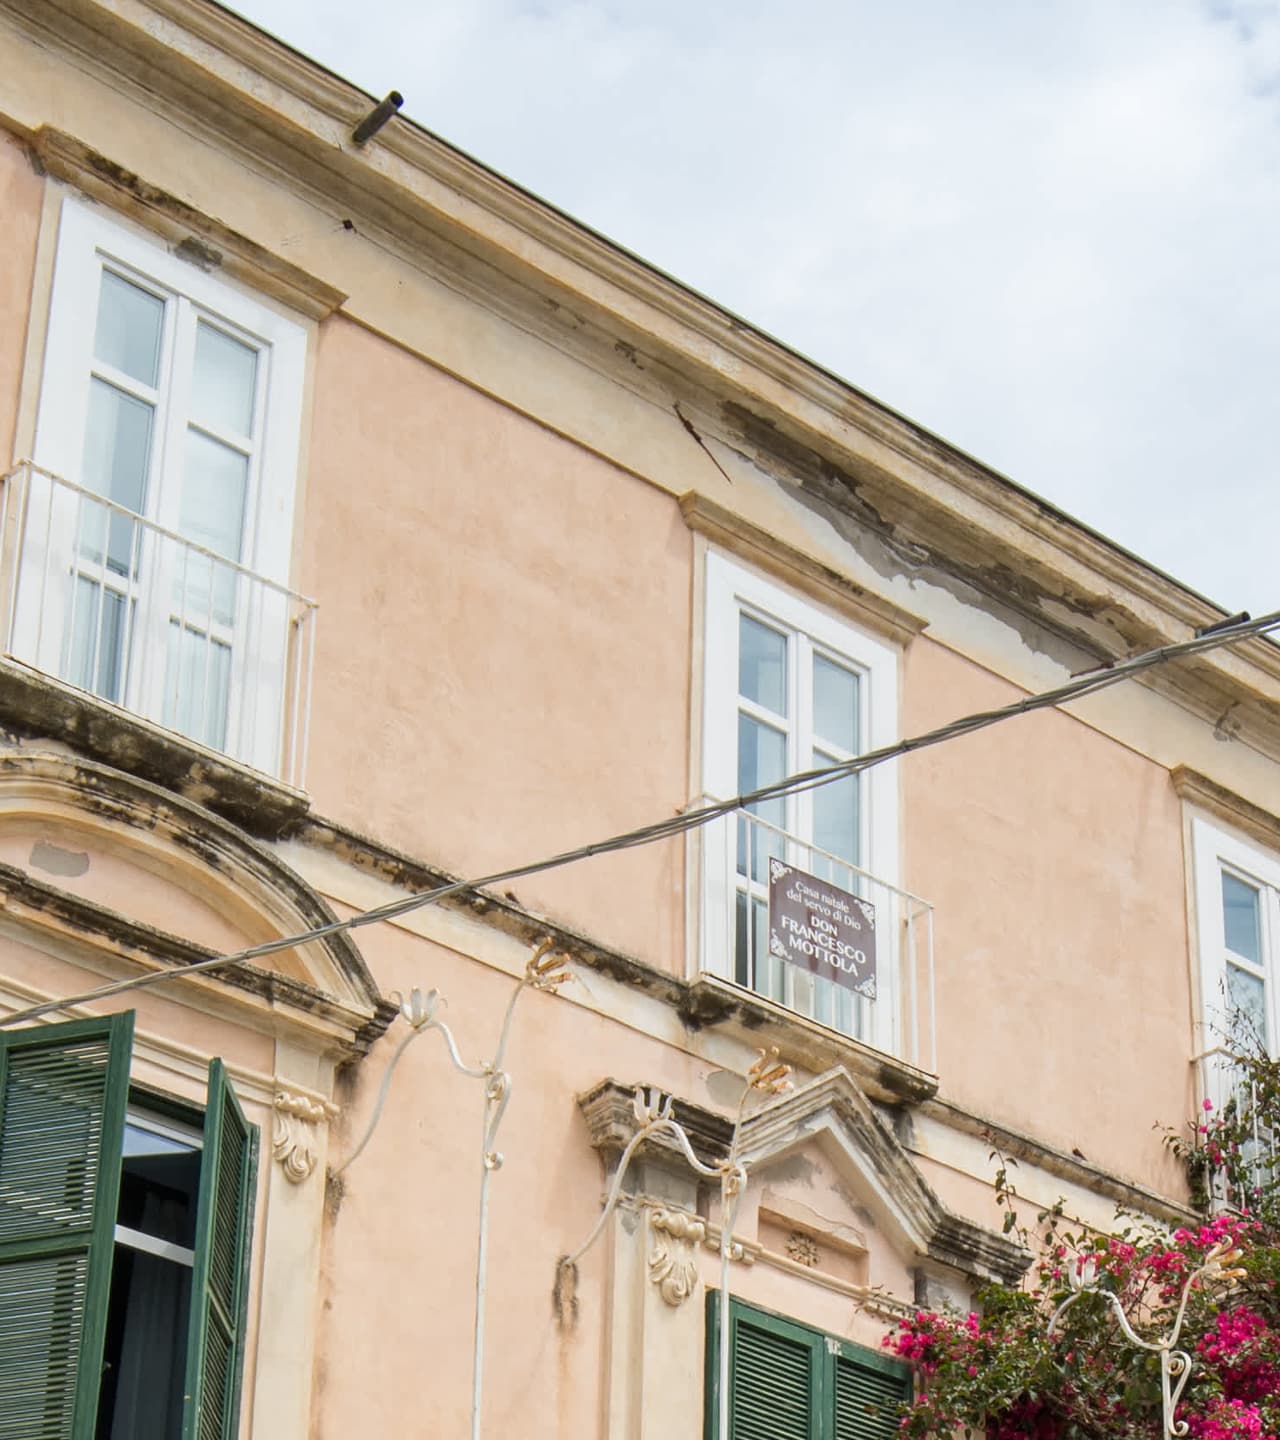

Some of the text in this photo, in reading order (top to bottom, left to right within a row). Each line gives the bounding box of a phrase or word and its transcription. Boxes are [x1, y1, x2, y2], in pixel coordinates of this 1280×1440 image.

[786, 889, 861, 931] del servo di Dio
[795, 881, 850, 912] Casa natale
[781, 915, 866, 964] FRANCESCO
[811, 916, 838, 935] DON
[789, 935, 859, 977] MOTTOLA
